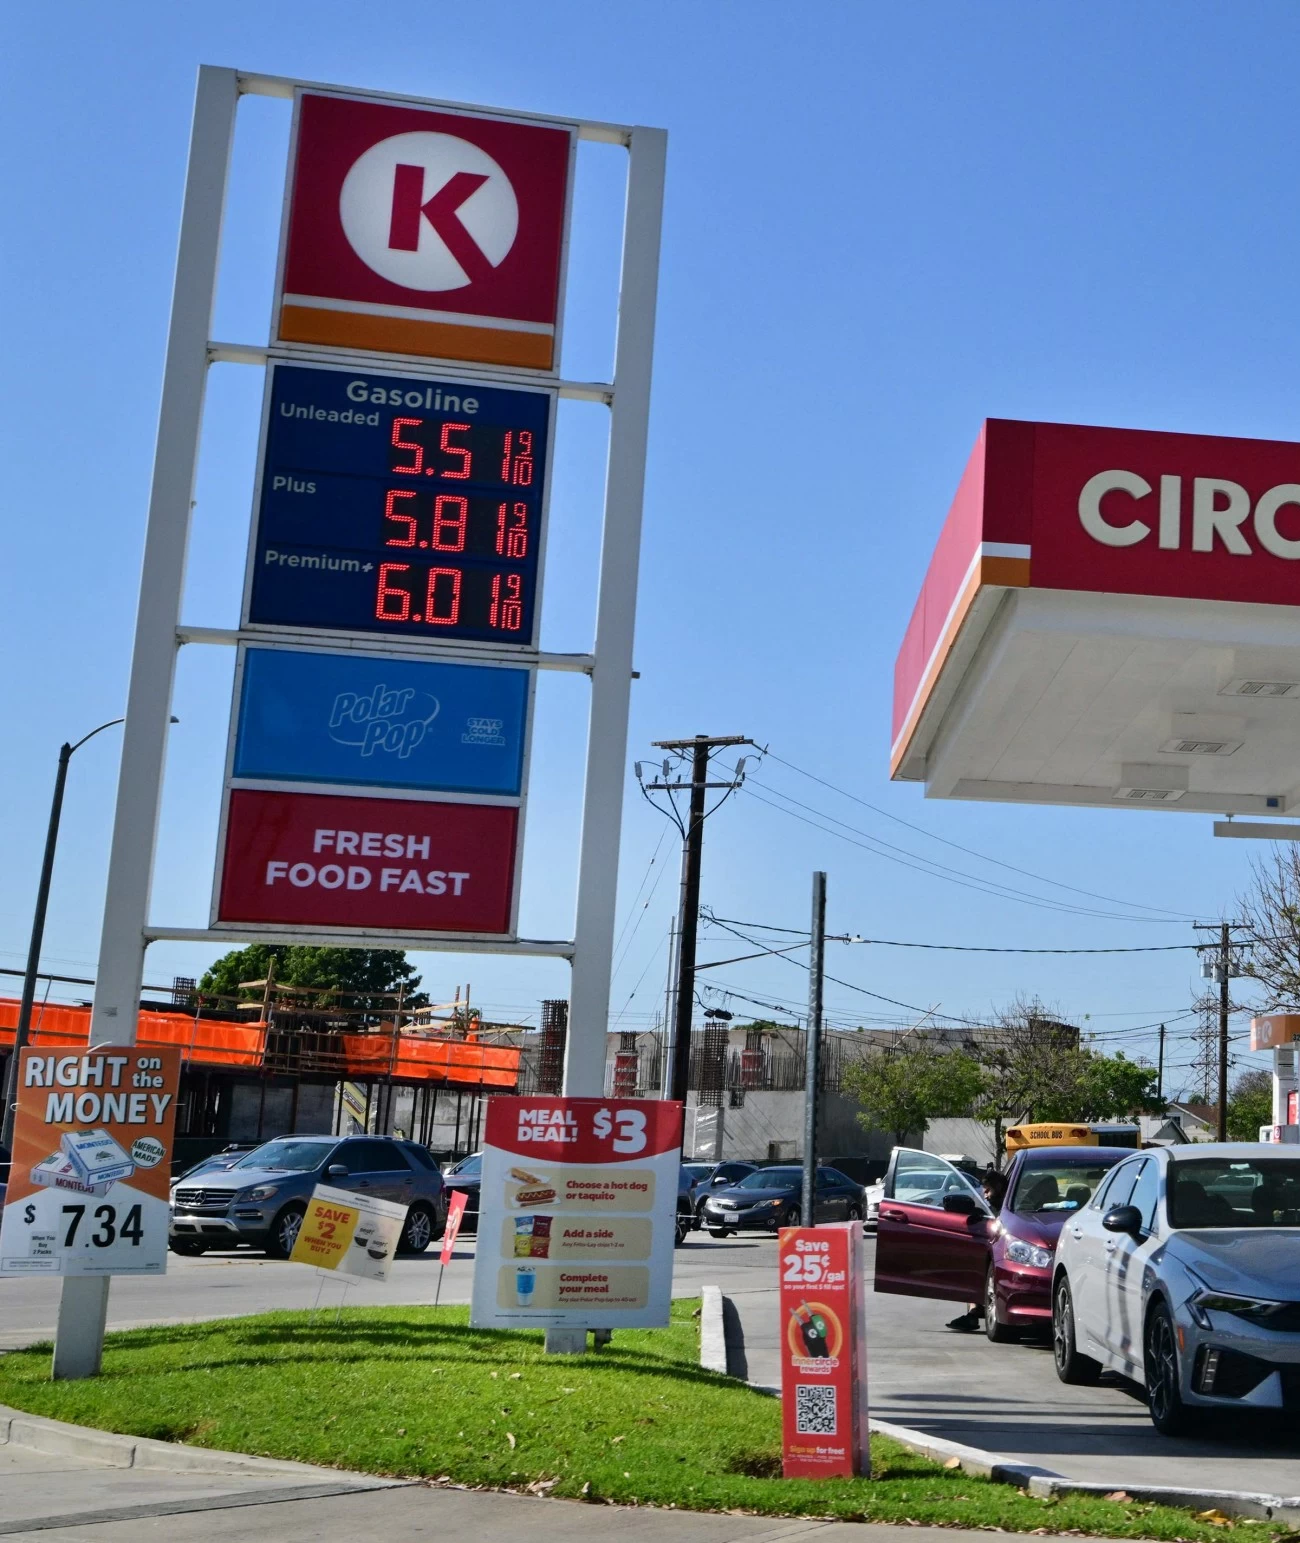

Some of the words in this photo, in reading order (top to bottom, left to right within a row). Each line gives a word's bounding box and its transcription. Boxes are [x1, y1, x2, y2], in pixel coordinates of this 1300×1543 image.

[346, 380, 480, 414] Gasoline
[280, 403, 380, 426] Unleaded
[272, 476, 317, 494] Plus
[328, 684, 416, 728] Polar
[467, 717, 503, 729] STAYS
[469, 726, 500, 737] COLD
[360, 719, 427, 759] Pop
[461, 734, 506, 746] LONGER
[313, 828, 431, 860] FRESH
[265, 860, 372, 890] FOOD
[379, 867, 470, 896] FAST
[24, 1055, 128, 1088] RIGHT
[137, 1057, 162, 1070] on
[132, 1072, 164, 1088] the
[45, 1092, 172, 1124] MONEY
[517, 1109, 578, 1126] MEAL
[517, 1125, 579, 1143] DEAL!
[592, 1108, 648, 1154] $3
[1029, 1131, 1051, 1140] SCHOOL
[1051, 1130, 1063, 1139] BUS
[133, 1140, 165, 1157] AMERICAN
[133, 1150, 157, 1164] MADE
[566, 1180, 602, 1190] Choose
[611, 1180, 629, 1190] hot
[629, 1181, 648, 1192] dog
[578, 1191, 616, 1202] taquito
[314, 1206, 351, 1224] SAVE
[24, 1203, 37, 1226] $
[62, 1203, 145, 1248] 7.34
[317, 1221, 337, 1240] $2
[563, 1229, 584, 1238] Add
[593, 1229, 614, 1238] side
[303, 1236, 327, 1247] WHEN
[327, 1241, 342, 1250] YOU
[310, 1244, 325, 1253] BUY
[795, 1239, 830, 1252] Save
[560, 1273, 608, 1284] Complete
[559, 1285, 583, 1295] your
[584, 1284, 609, 1293] meal
[801, 1365, 831, 1374] rewards
